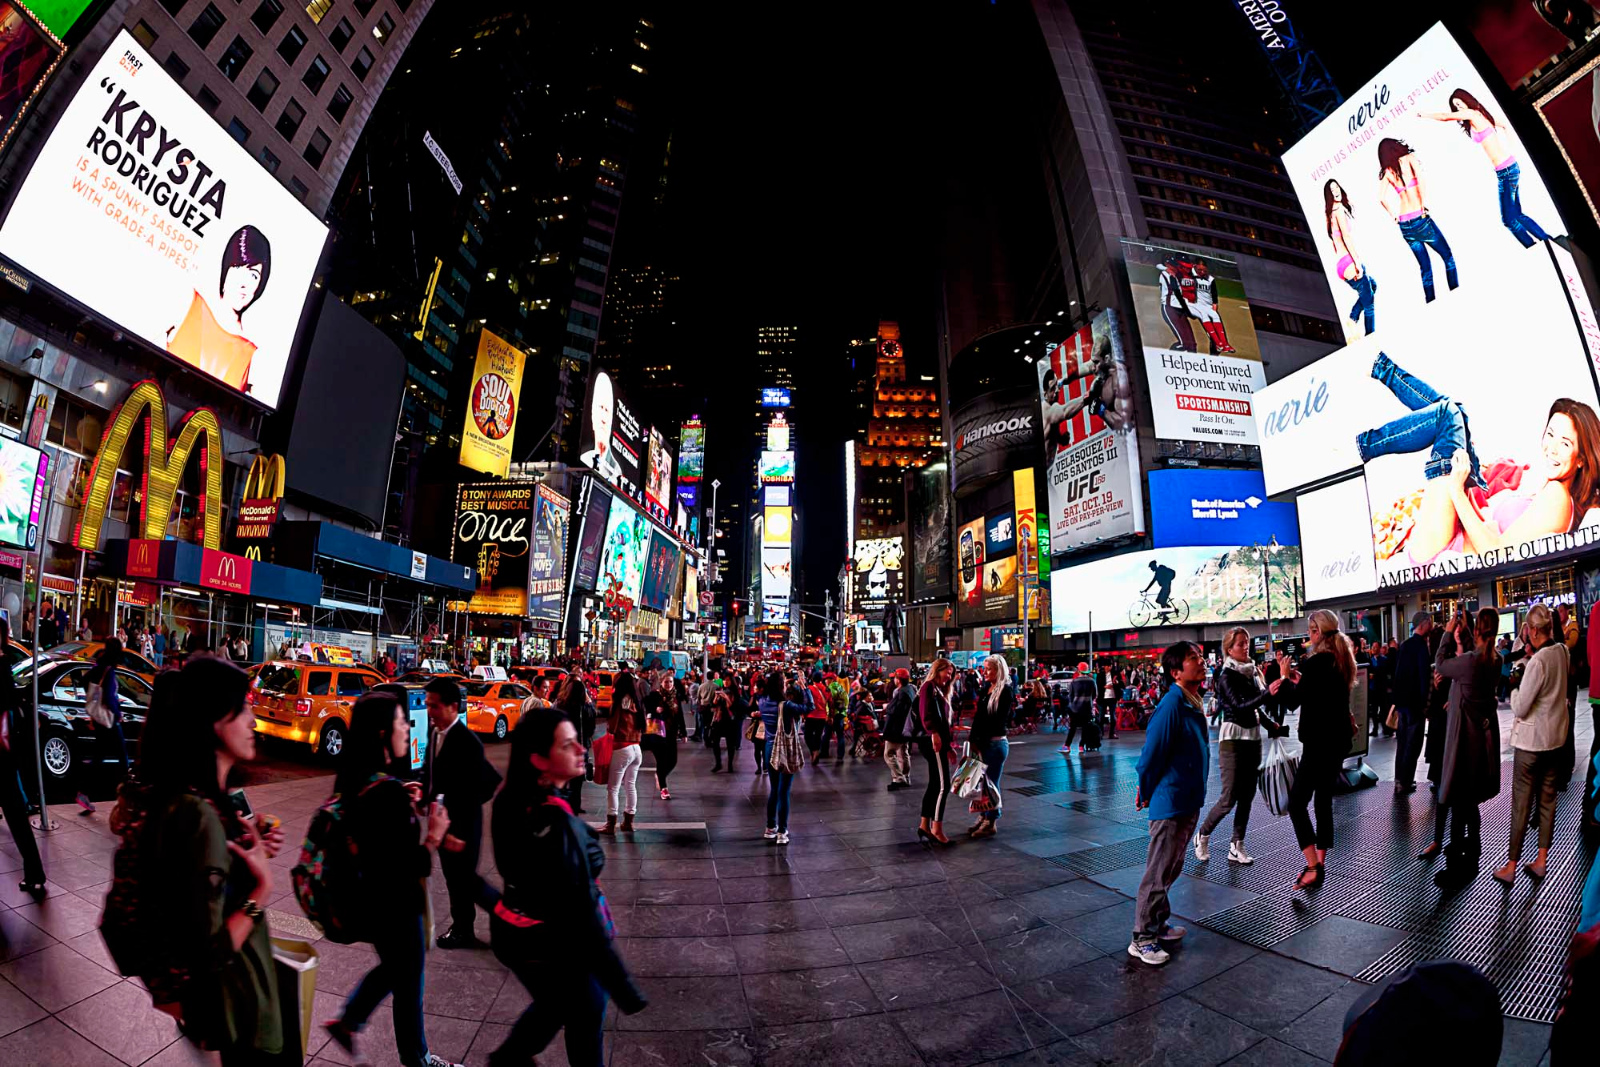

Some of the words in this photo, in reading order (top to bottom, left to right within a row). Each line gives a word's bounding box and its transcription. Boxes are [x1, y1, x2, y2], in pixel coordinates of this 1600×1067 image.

[124, 50, 143, 70] FIRST
[1348, 84, 1390, 135] aerie
[1311, 159, 1332, 181] VISIT
[1334, 150, 1347, 164] US
[1347, 126, 1376, 153] INSIDE
[1377, 115, 1390, 130] ON
[1390, 101, 1408, 119] THE
[1422, 68, 1449, 94] LEVEL
[434, 147, 450, 172] STEEL
[72, 176, 103, 207] WITH
[86, 126, 211, 238] RODRIGUEZ
[76, 155, 89, 172] IS
[90, 168, 99, 181] A
[101, 176, 149, 216] SPUNKY
[150, 213, 199, 255] SASSPOT
[1161, 354, 1208, 374] Helped
[1210, 359, 1252, 379] injured
[481, 374, 511, 403] SOUL
[1165, 374, 1226, 391] opponent
[1227, 379, 1254, 394] win.
[480, 396, 510, 420] DOCTOR
[1178, 396, 1249, 413] SPORTSMANSHIP
[1264, 377, 1329, 439] aerie
[1192, 427, 1223, 435] VALUES.COM
[1199, 413, 1214, 423] Pass
[1214, 415, 1221, 423] It
[996, 429, 1033, 441] emotion
[1054, 471, 1069, 485] DOS
[1070, 455, 1105, 478] SANTOS
[1107, 447, 1118, 461] III
[1055, 441, 1103, 472] VELASQUEZ
[1103, 435, 1114, 449] VS
[462, 491, 468, 499] 8
[469, 490, 493, 499] TONY
[493, 489, 531, 499] AWARDS
[1067, 469, 1102, 503] UFC
[240, 506, 276, 515] McDonald's
[461, 501, 485, 510] BEST
[487, 500, 530, 510] MUSICAL
[1056, 517, 1069, 530] LIVE
[1070, 515, 1079, 525] ON
[1079, 499, 1124, 521] PAY-PER-VIEW
[1063, 504, 1080, 519] SAT.
[1082, 497, 1100, 513] OCT.
[1102, 491, 1113, 503] 19
[1217, 509, 1239, 520] Lynch
[1320, 551, 1361, 580] aerie
[1379, 558, 1459, 588] AMERICAN
[1464, 546, 1515, 570] EAGLE
[1542, 592, 1576, 608] JEANS
